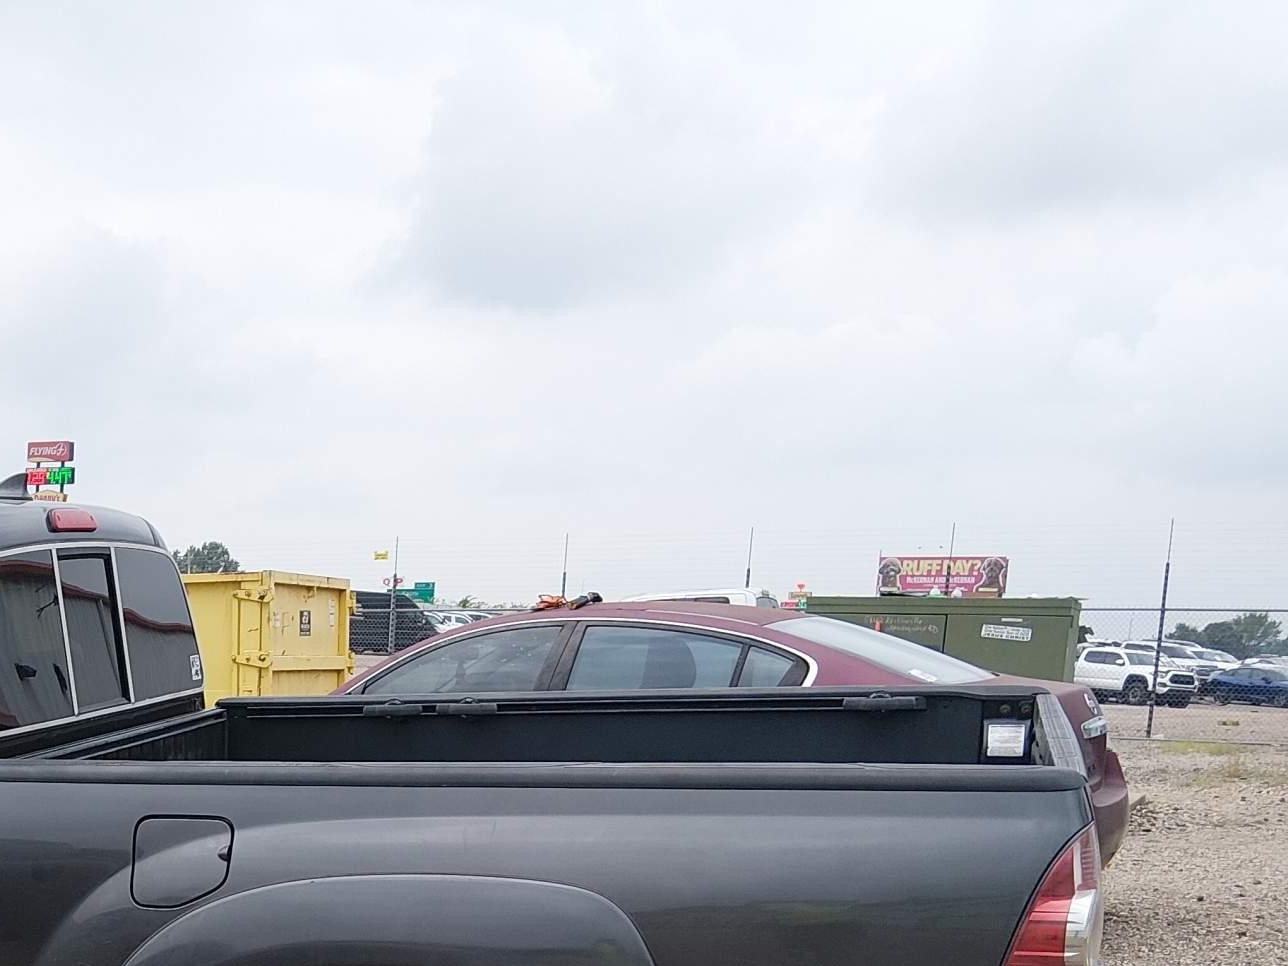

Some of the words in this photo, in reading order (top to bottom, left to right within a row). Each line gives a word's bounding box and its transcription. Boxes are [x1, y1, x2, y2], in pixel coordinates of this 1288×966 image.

[29, 446, 57, 456] FLYING
[902, 559, 942, 575] RUFF
[942, 559, 982, 575] DAY?
